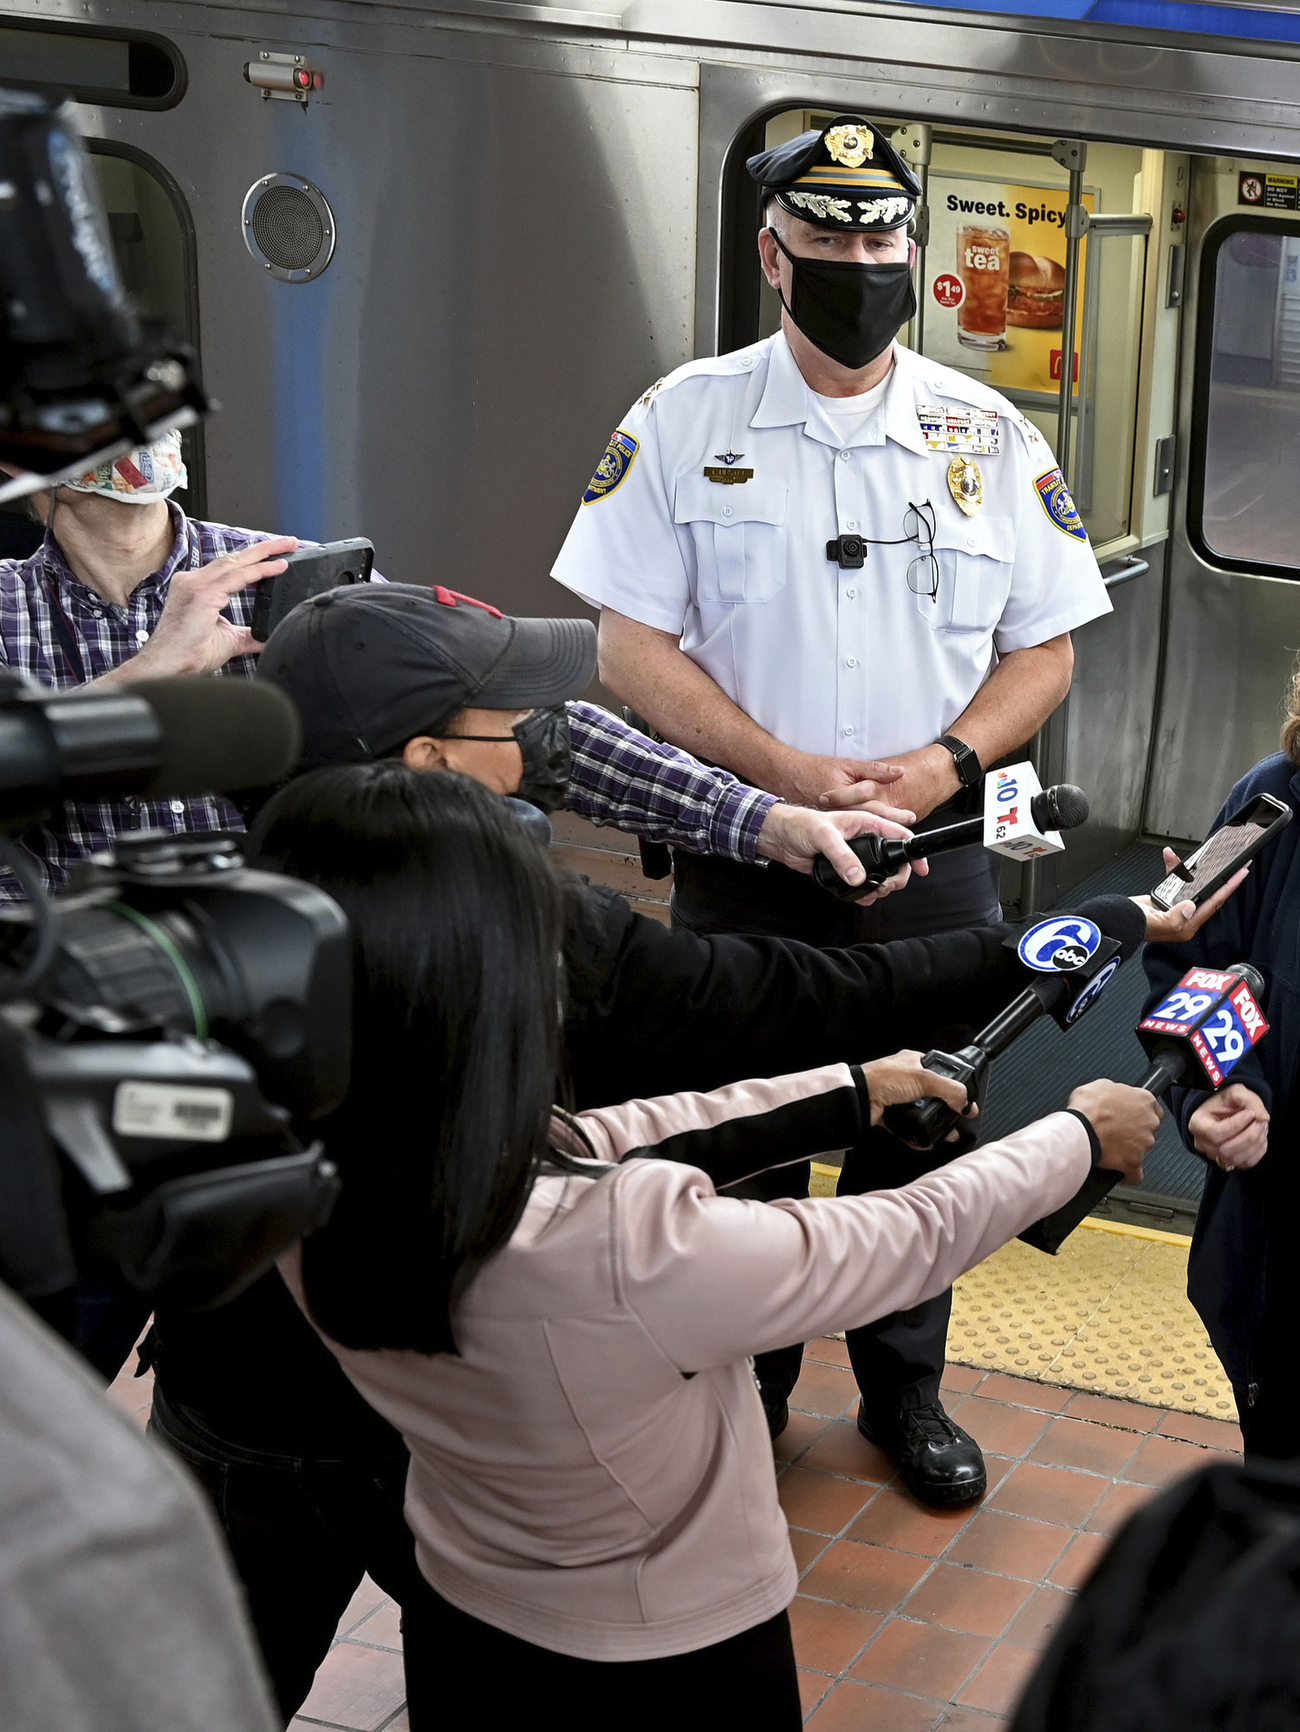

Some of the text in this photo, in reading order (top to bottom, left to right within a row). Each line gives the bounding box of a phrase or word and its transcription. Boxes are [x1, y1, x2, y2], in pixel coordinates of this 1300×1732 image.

[947, 195, 1010, 218] Sweet.
[965, 248, 1000, 270] tea
[972, 245, 1000, 255] sweet
[189, 546, 200, 571] IBE
[1055, 949, 1086, 966] abc
[1186, 972, 1231, 991] FOX
[1154, 992, 1212, 1020] 29
[1233, 987, 1264, 1037] FOX
[1143, 1020, 1188, 1033] NEWS
[1202, 1009, 1244, 1062] 29
[1193, 1035, 1221, 1083] NEWS
